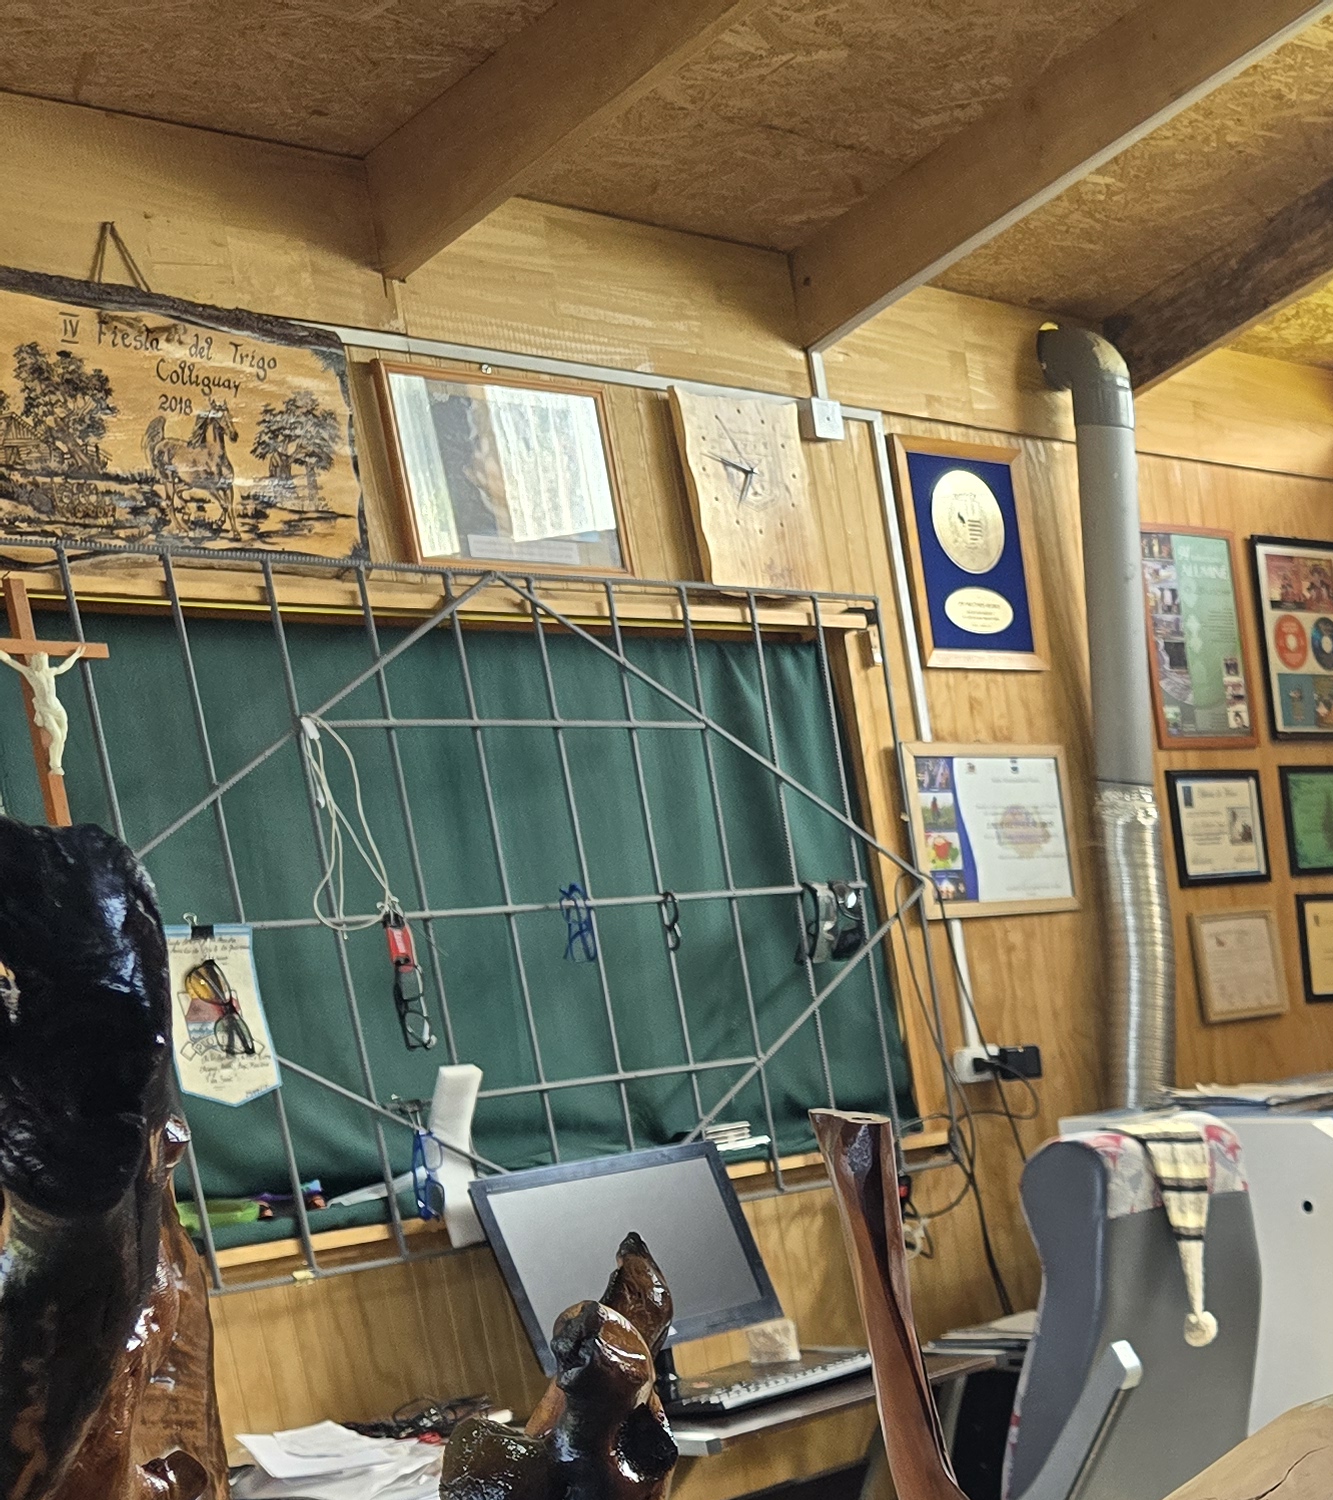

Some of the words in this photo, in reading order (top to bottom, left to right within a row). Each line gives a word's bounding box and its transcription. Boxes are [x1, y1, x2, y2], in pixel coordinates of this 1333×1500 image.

[59, 311, 79, 344] IV
[189, 333, 213, 361] del
[229, 341, 278, 382] Trigo
[157, 393, 193, 415] 2018
